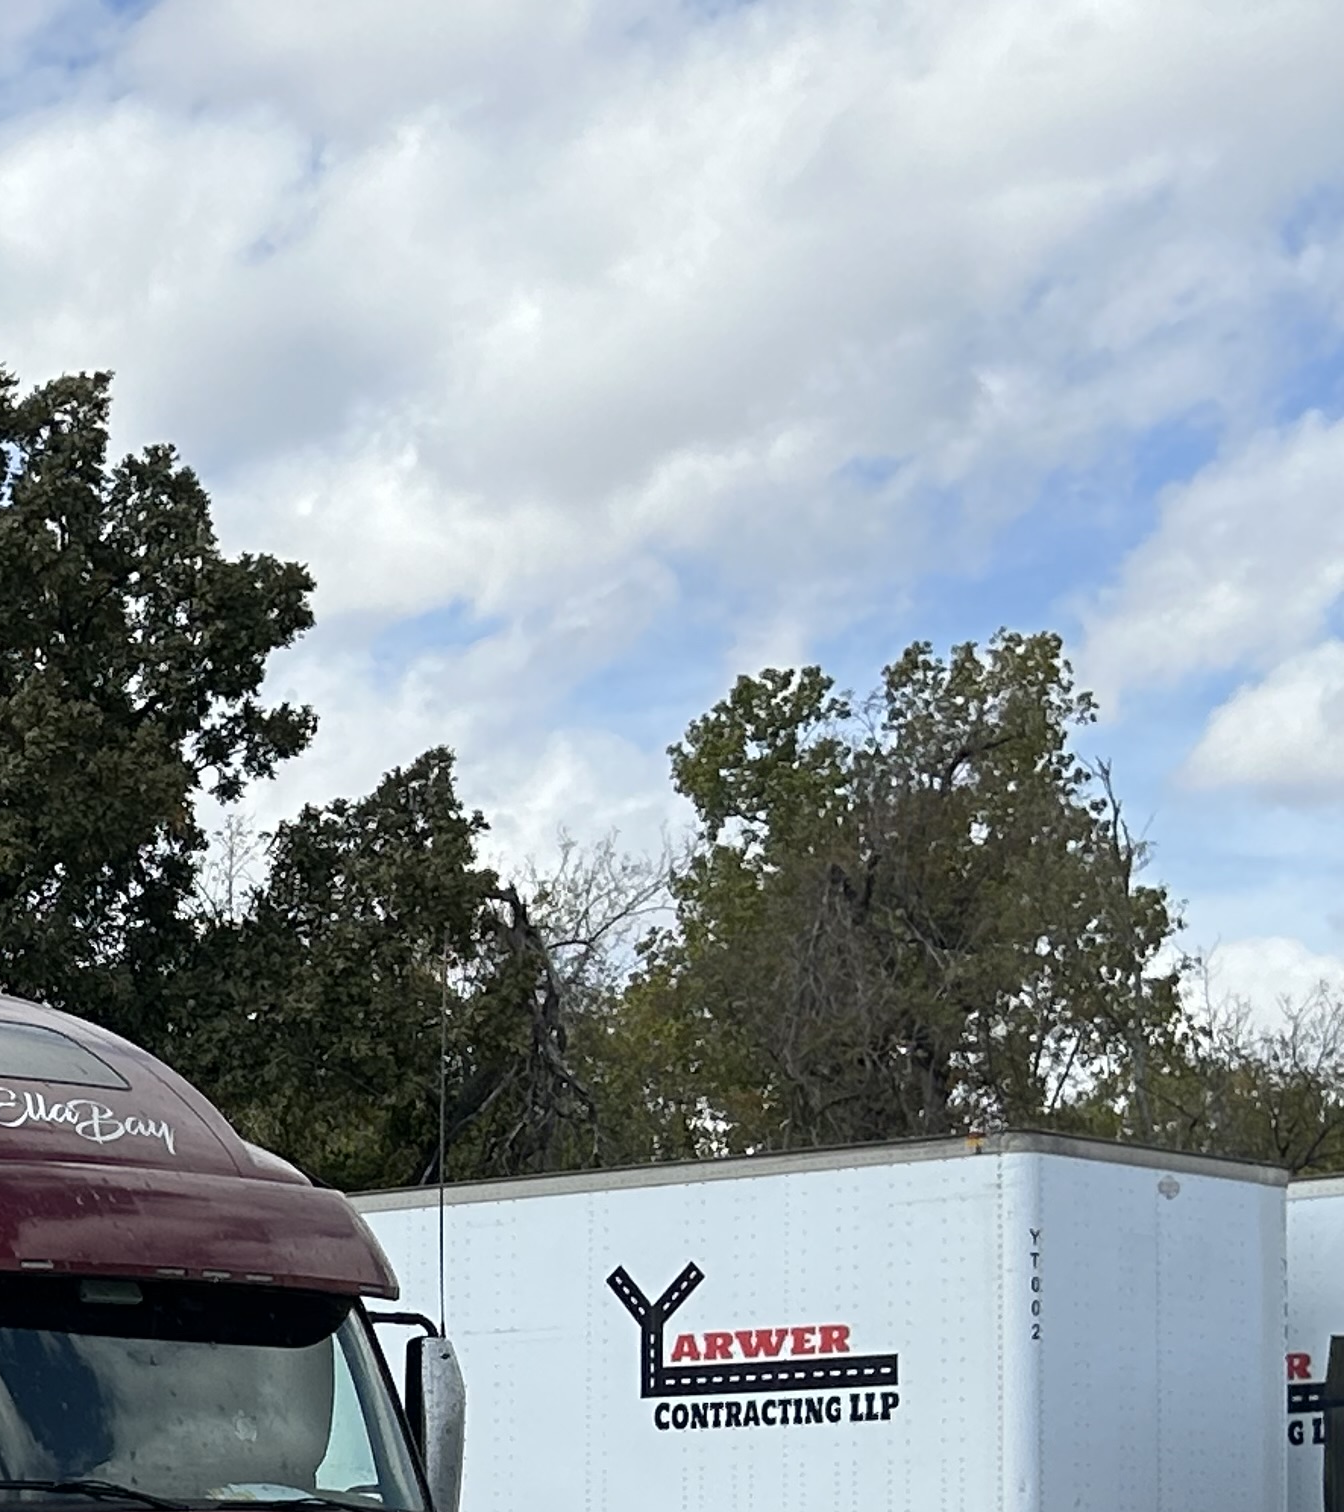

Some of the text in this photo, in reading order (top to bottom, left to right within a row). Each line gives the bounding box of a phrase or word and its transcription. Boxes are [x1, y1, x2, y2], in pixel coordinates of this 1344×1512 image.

[1029, 1227, 1041, 1340] YT002
[654, 1392, 900, 1431] CONTRACTING LLP
